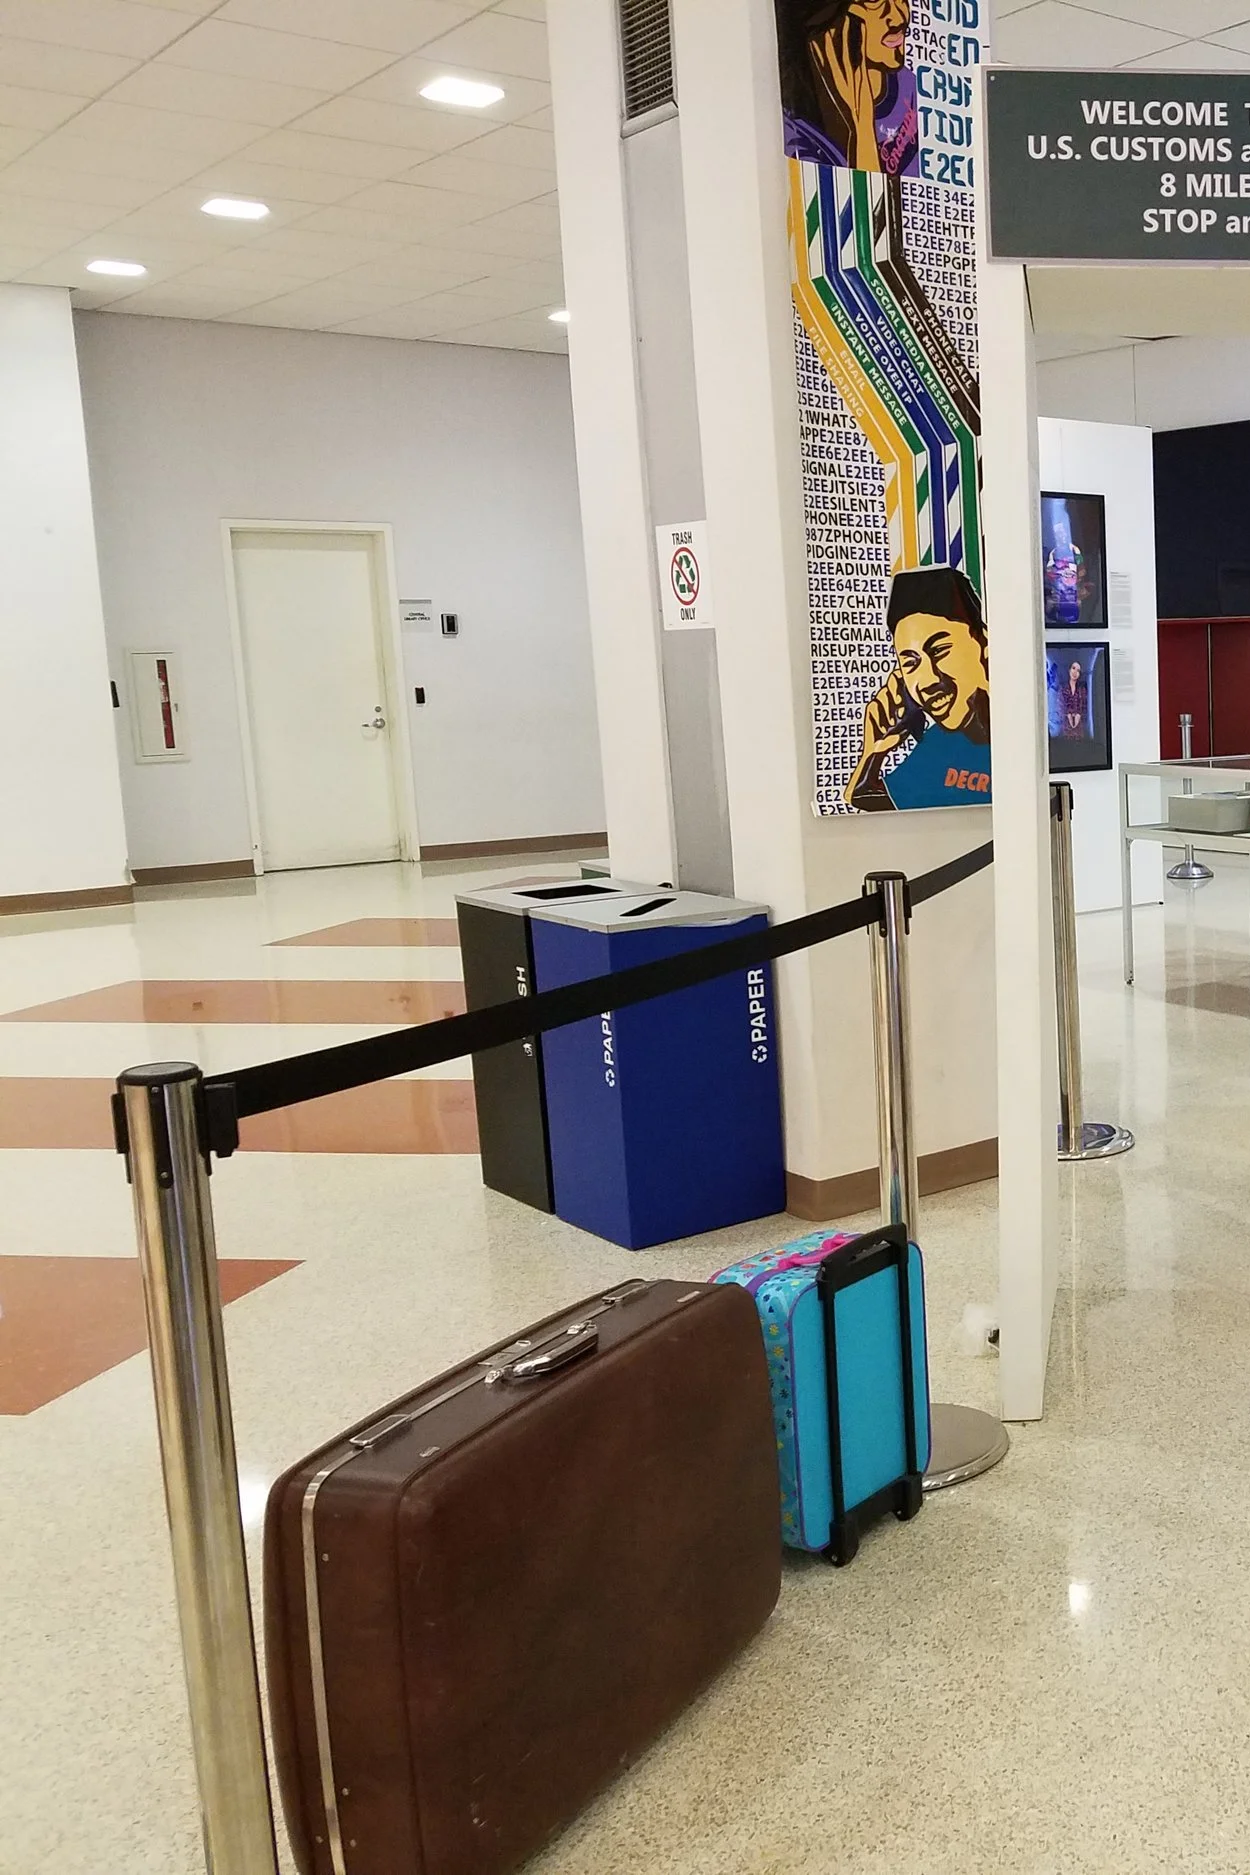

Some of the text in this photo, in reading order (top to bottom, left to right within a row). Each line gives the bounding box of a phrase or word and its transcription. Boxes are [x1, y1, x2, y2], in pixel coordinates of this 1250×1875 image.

[1081, 101, 1229, 127] WELCOME
[1027, 135, 1082, 161] U.S.
[1090, 136, 1233, 162] CUSTOMS
[1159, 173, 1176, 198] 8
[1142, 209, 1218, 234] STOP
[830, 303, 908, 426] INSTANT MESSAGE
[839, 350, 866, 391] EMAIL
[855, 313, 913, 404] VOICE OVER IP
[870, 278, 961, 430] SOCIAL MEDIA MESSAGE
[876, 316, 925, 394] VIDEO CHAT
[902, 296, 958, 394] TEXT MESSAGE
[923, 307, 972, 390] PHONE CALL
[826, 358, 864, 418] SHARING
[671, 531, 693, 545] TRASH
[680, 607, 696, 620] ONLY
[747, 968, 768, 1043] PAPER
